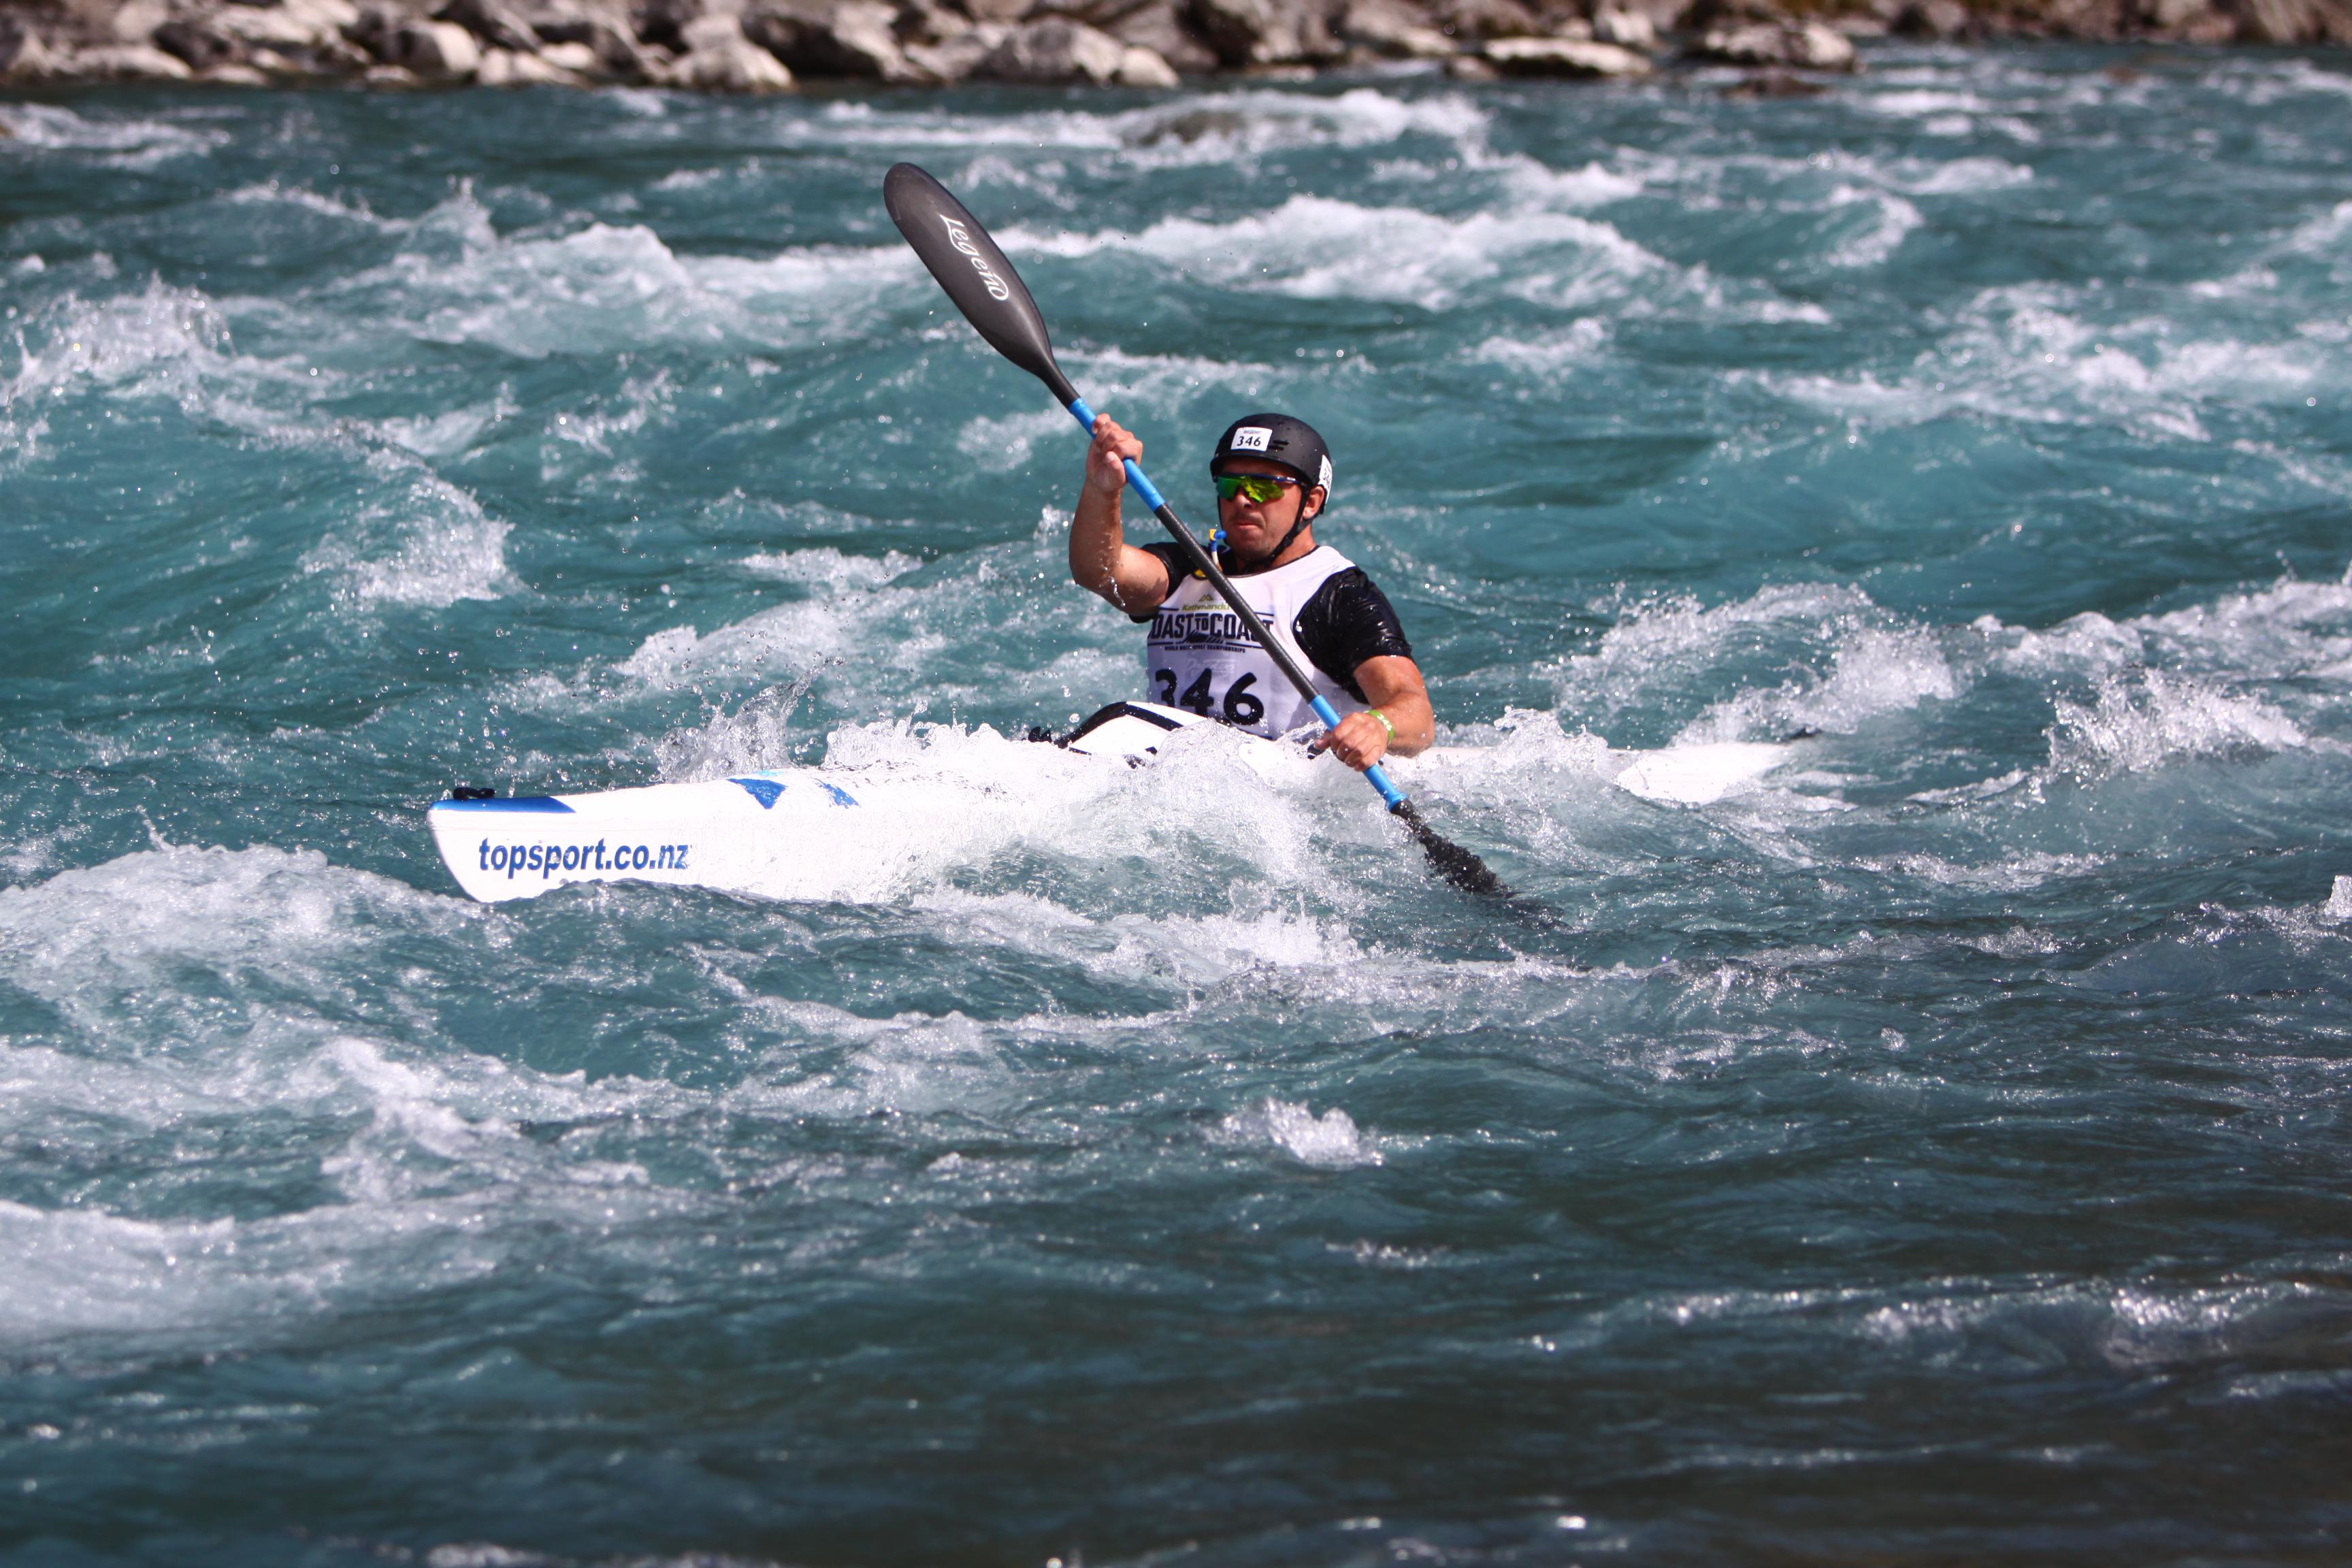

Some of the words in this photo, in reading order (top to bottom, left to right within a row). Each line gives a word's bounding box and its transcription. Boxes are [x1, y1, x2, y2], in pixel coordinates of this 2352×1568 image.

[938, 212, 1010, 301] Legend
[1237, 435, 1261, 447] 346
[1147, 614, 1194, 640] OAST
[1195, 617, 1209, 632] TO
[1210, 613, 1274, 642] COAT
[1207, 644, 1246, 653] CHAMPIONSHIPS
[1155, 668, 1264, 726] 346
[478, 837, 689, 879] topsport.co.nz
